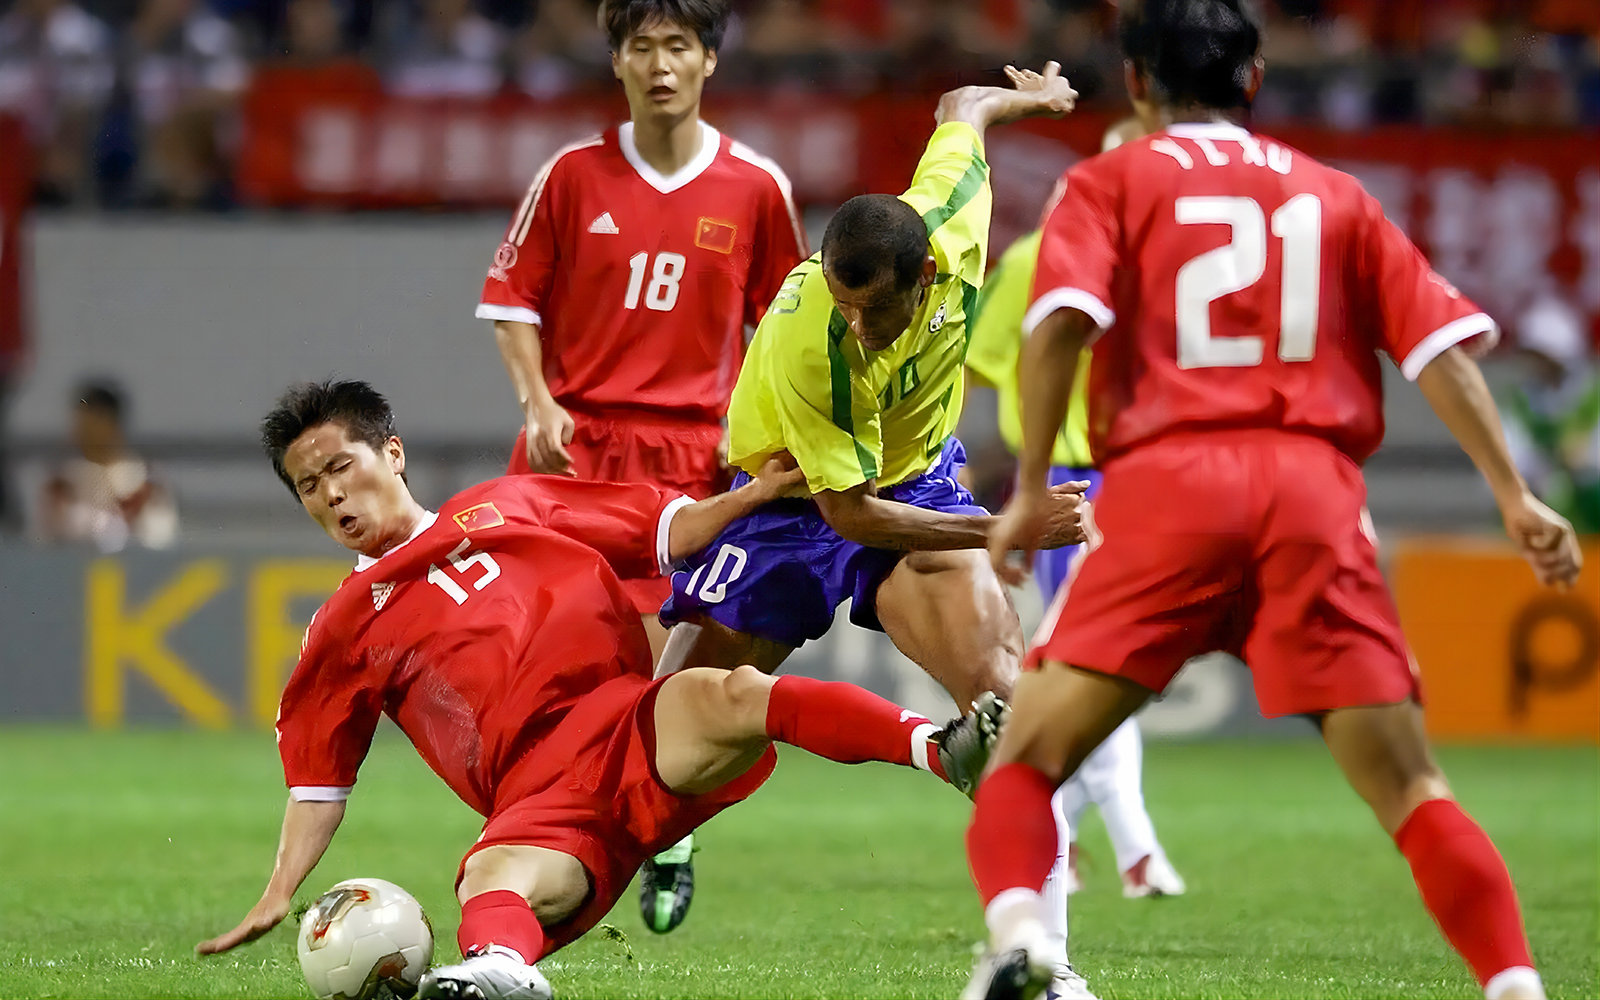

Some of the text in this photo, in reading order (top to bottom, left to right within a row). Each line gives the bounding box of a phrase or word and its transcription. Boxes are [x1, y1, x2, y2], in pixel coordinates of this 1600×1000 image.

[625, 251, 686, 311] 18
[1175, 193, 1321, 370] 21
[427, 537, 501, 606] 15
[685, 543, 747, 603] 10
